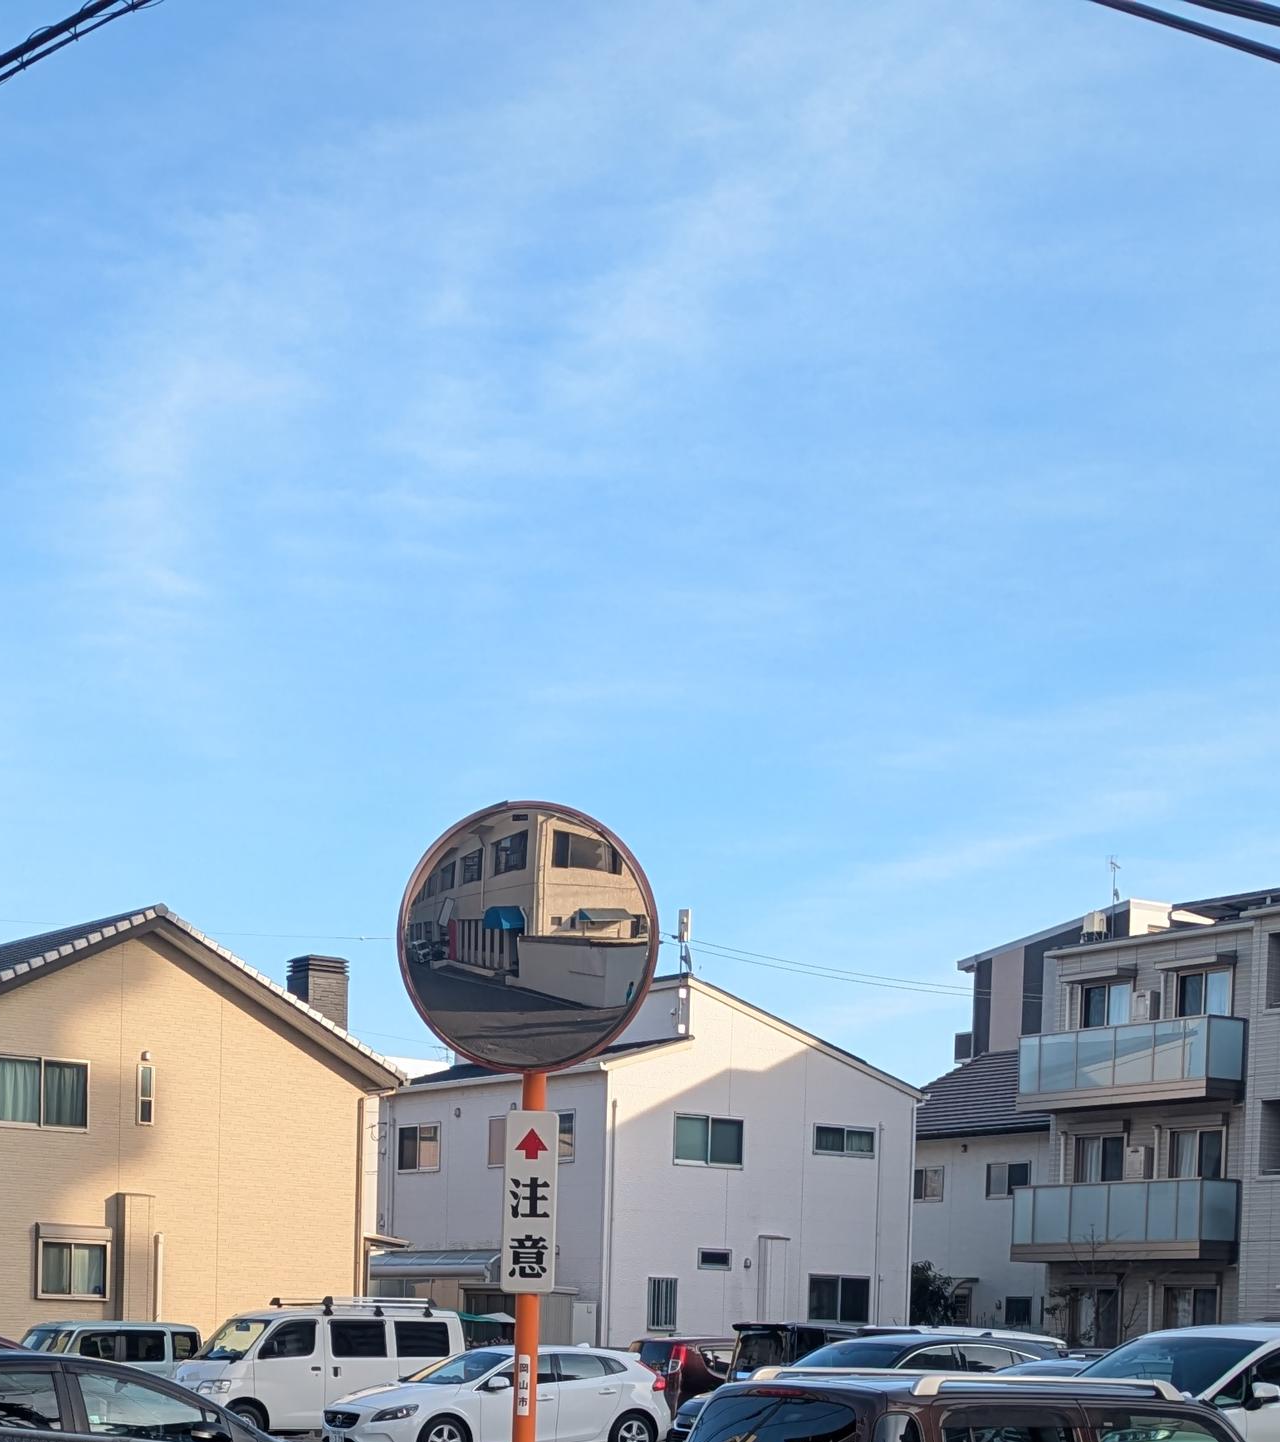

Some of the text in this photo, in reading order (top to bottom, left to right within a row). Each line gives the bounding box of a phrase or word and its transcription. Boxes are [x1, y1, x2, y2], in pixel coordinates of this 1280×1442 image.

[509, 1176, 550, 1279] 注意
[518, 1363, 529, 1407] 岡山市
